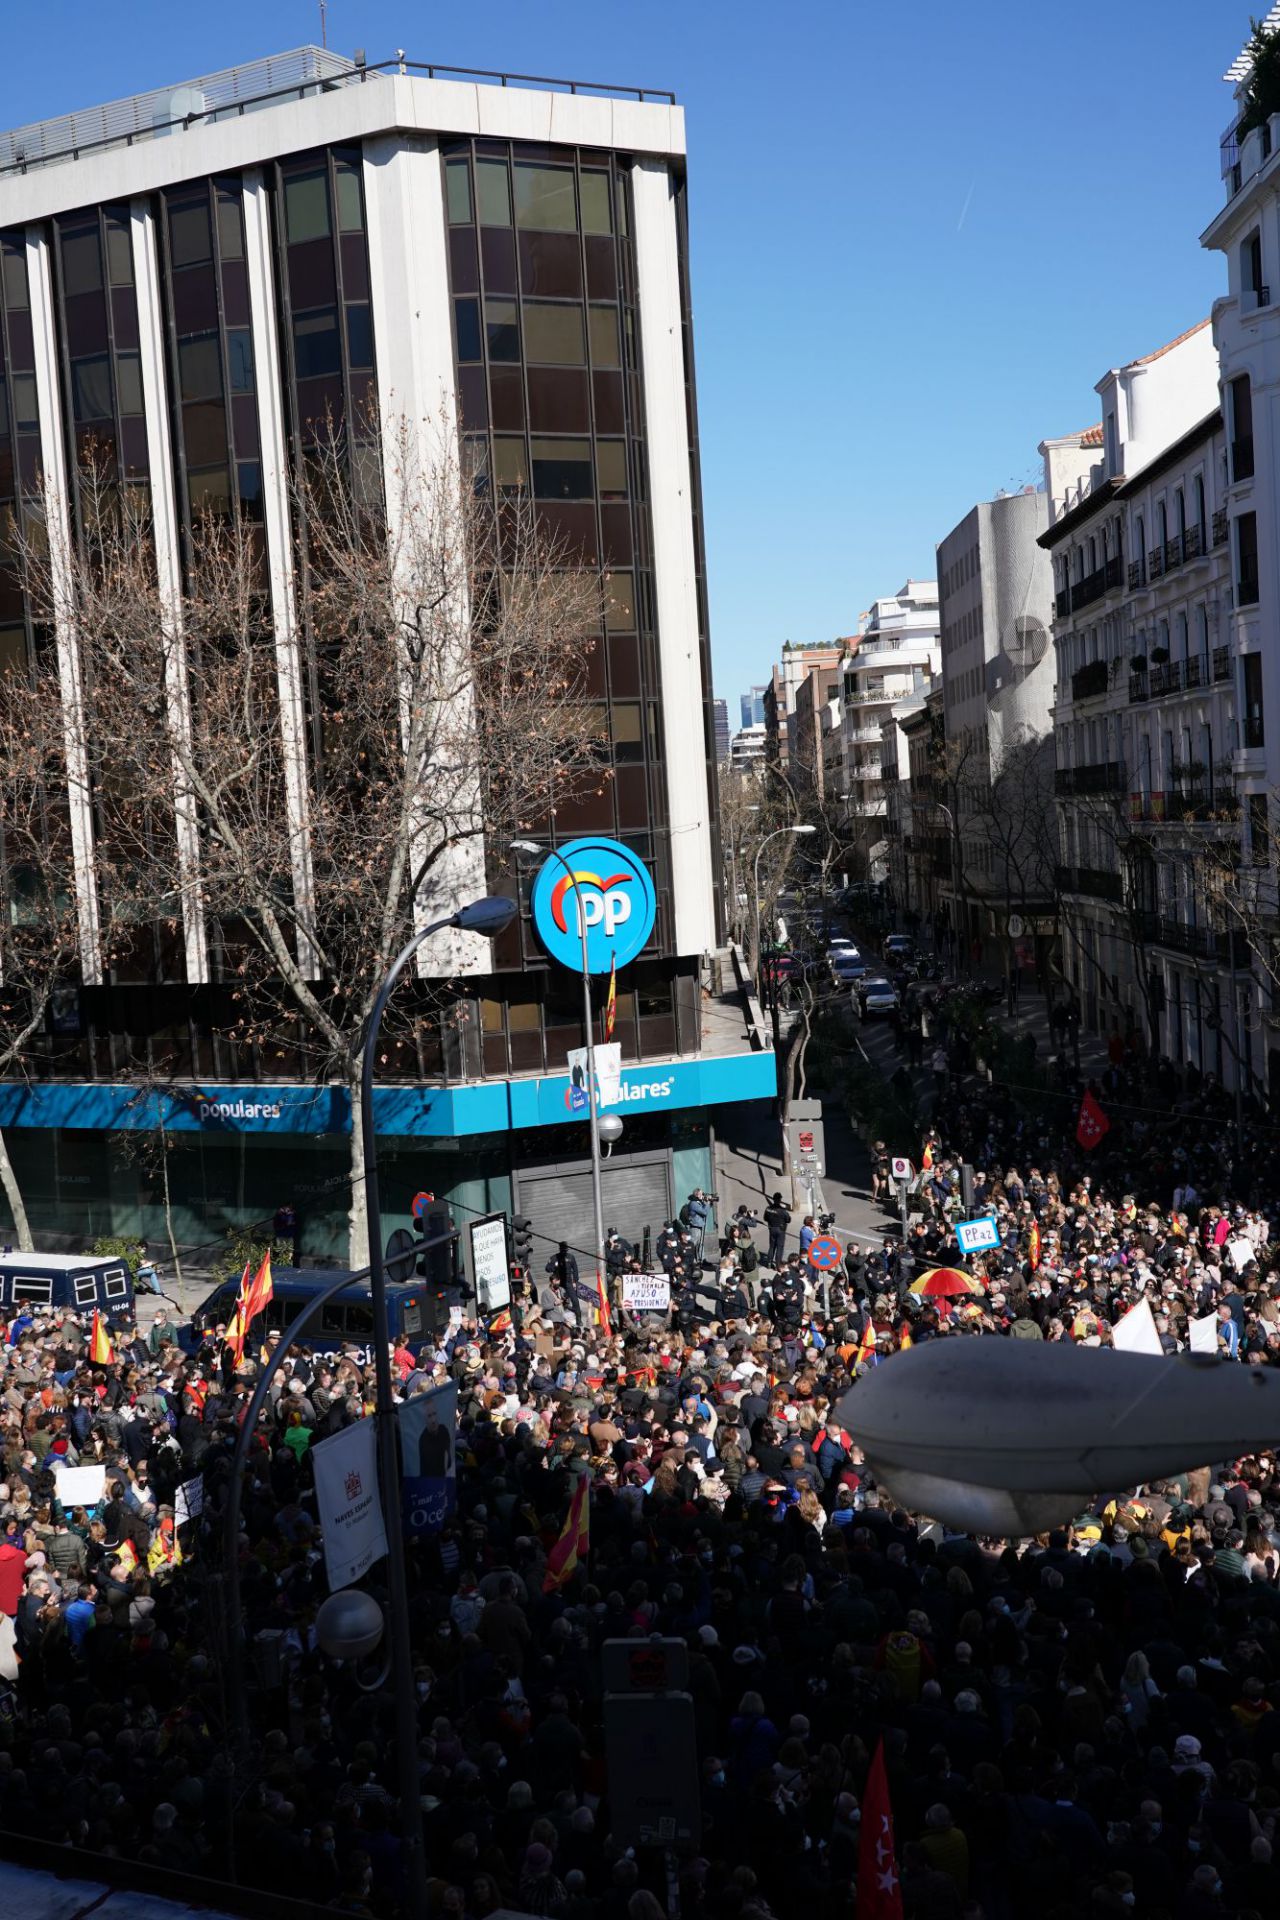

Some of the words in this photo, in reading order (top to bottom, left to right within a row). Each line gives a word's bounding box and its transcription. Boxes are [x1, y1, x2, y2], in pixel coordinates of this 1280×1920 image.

[576, 888, 633, 938] pp
[200, 1099, 281, 1122] populares
[630, 1289, 657, 1298] AYUSO
